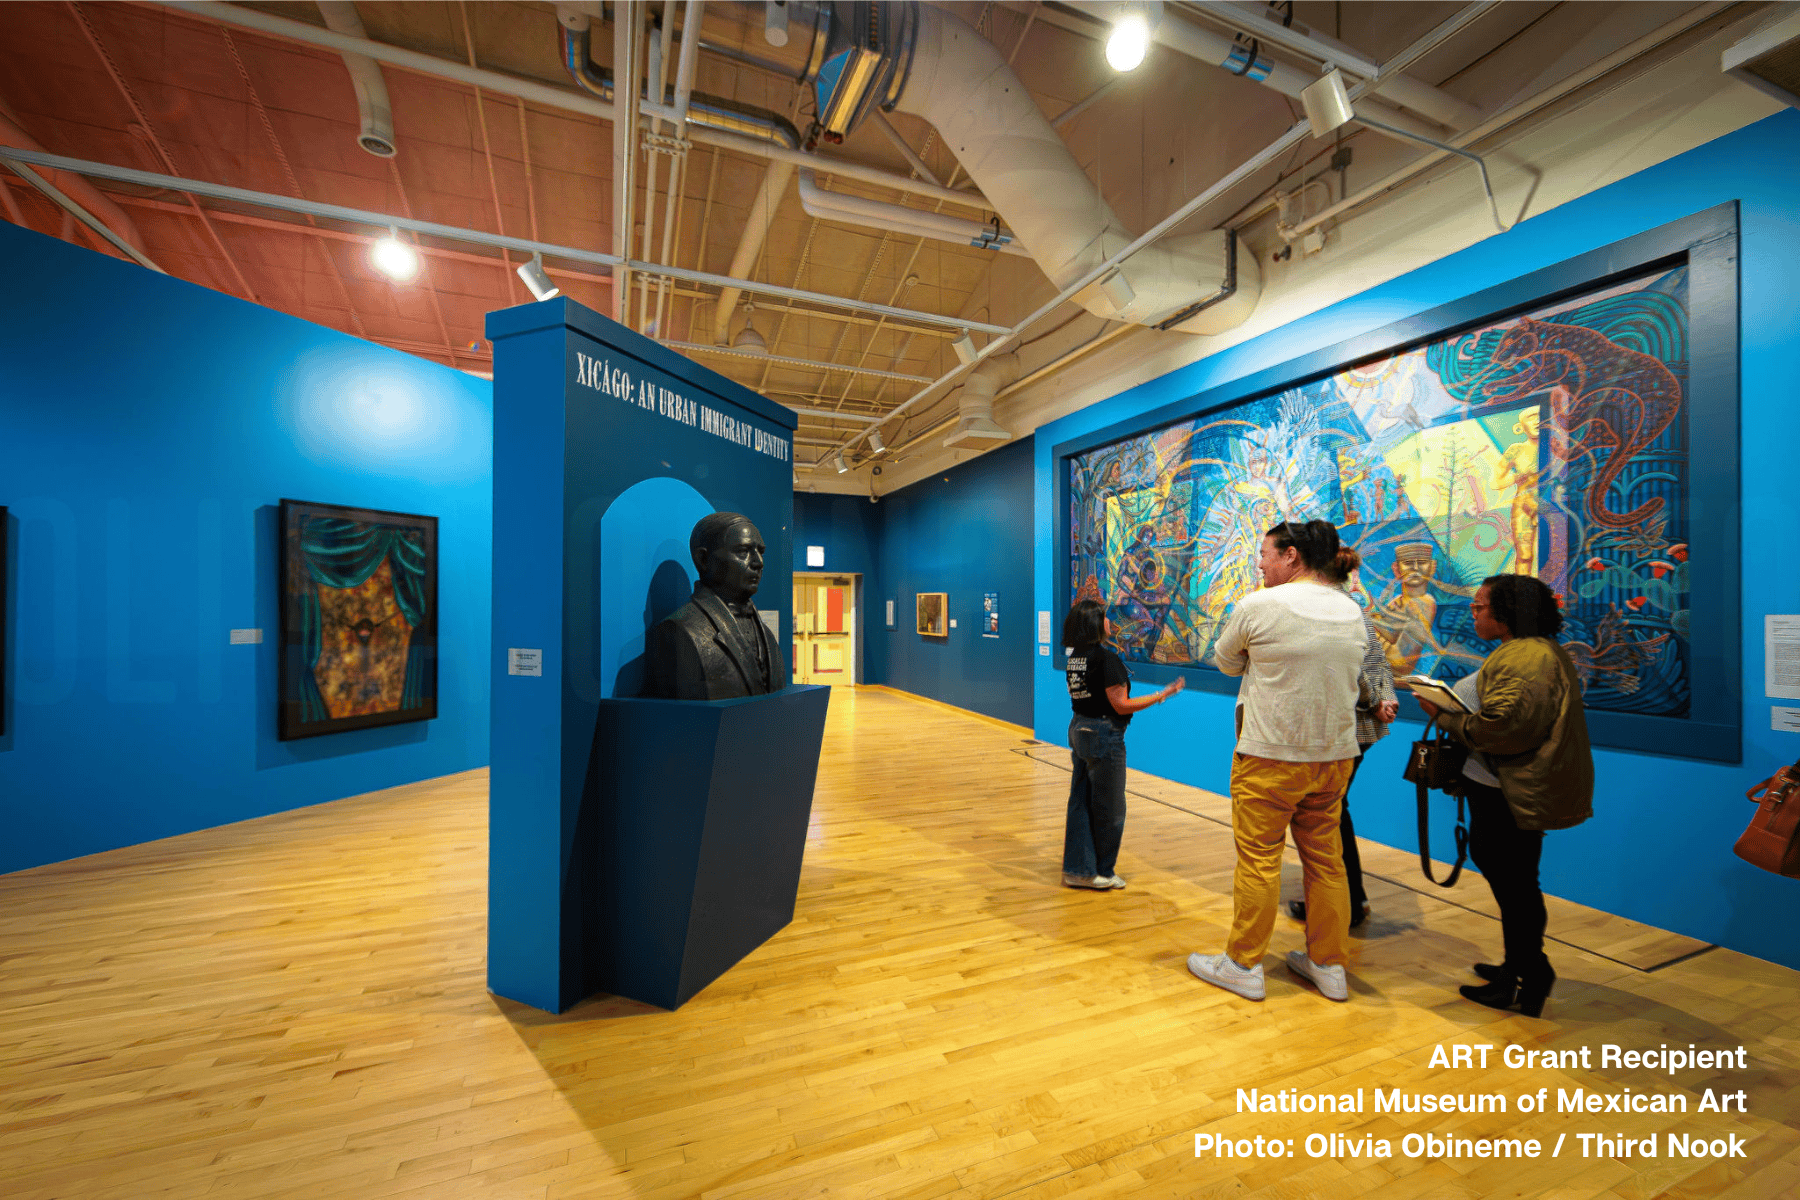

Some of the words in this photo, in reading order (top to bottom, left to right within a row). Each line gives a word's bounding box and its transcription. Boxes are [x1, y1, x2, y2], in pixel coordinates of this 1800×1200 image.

[576, 352, 635, 404] XICÁGO:
[638, 380, 656, 412] AN
[659, 387, 697, 428] URBAN
[700, 405, 753, 449] IMMIGRANT
[755, 428, 790, 462] IDENTITY
